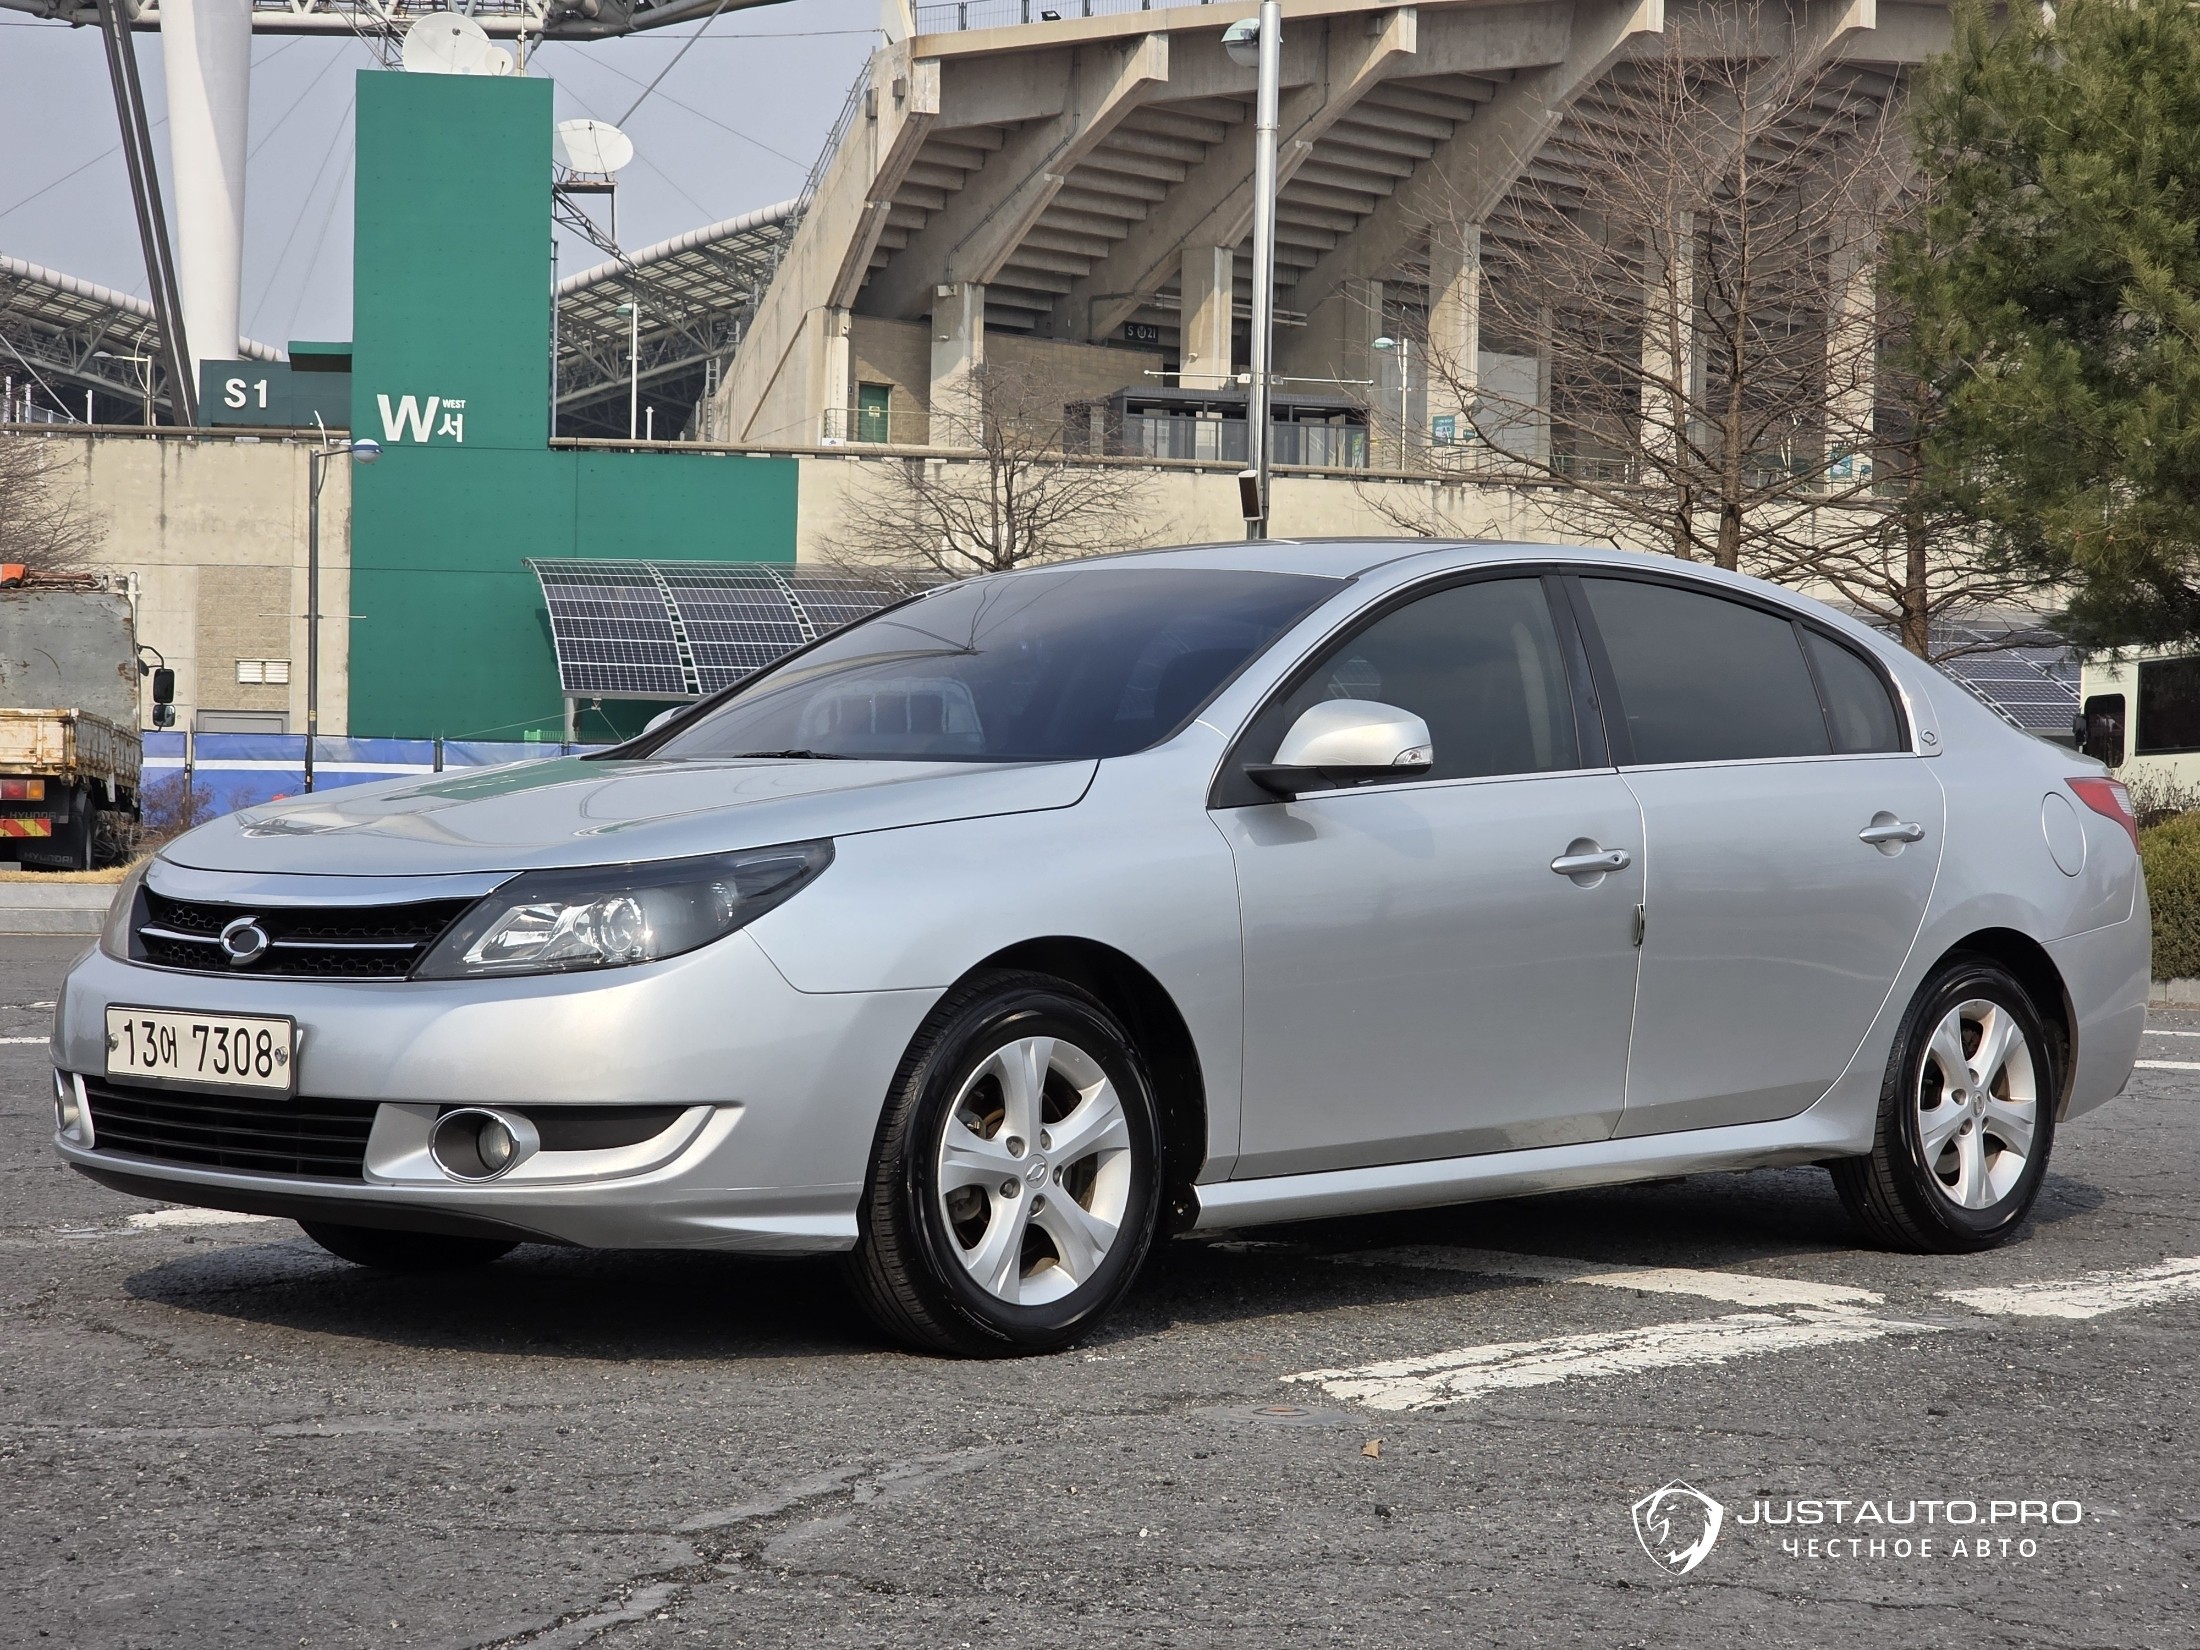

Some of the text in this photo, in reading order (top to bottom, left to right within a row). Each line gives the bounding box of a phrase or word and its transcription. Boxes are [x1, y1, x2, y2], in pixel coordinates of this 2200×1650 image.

[377, 394, 440, 442] W
[442, 399, 466, 409] WEST
[437, 413, 463, 443] 서
[24, 852, 73, 864] HYUNDAI
[124, 1019, 273, 1078] 13어 7308
